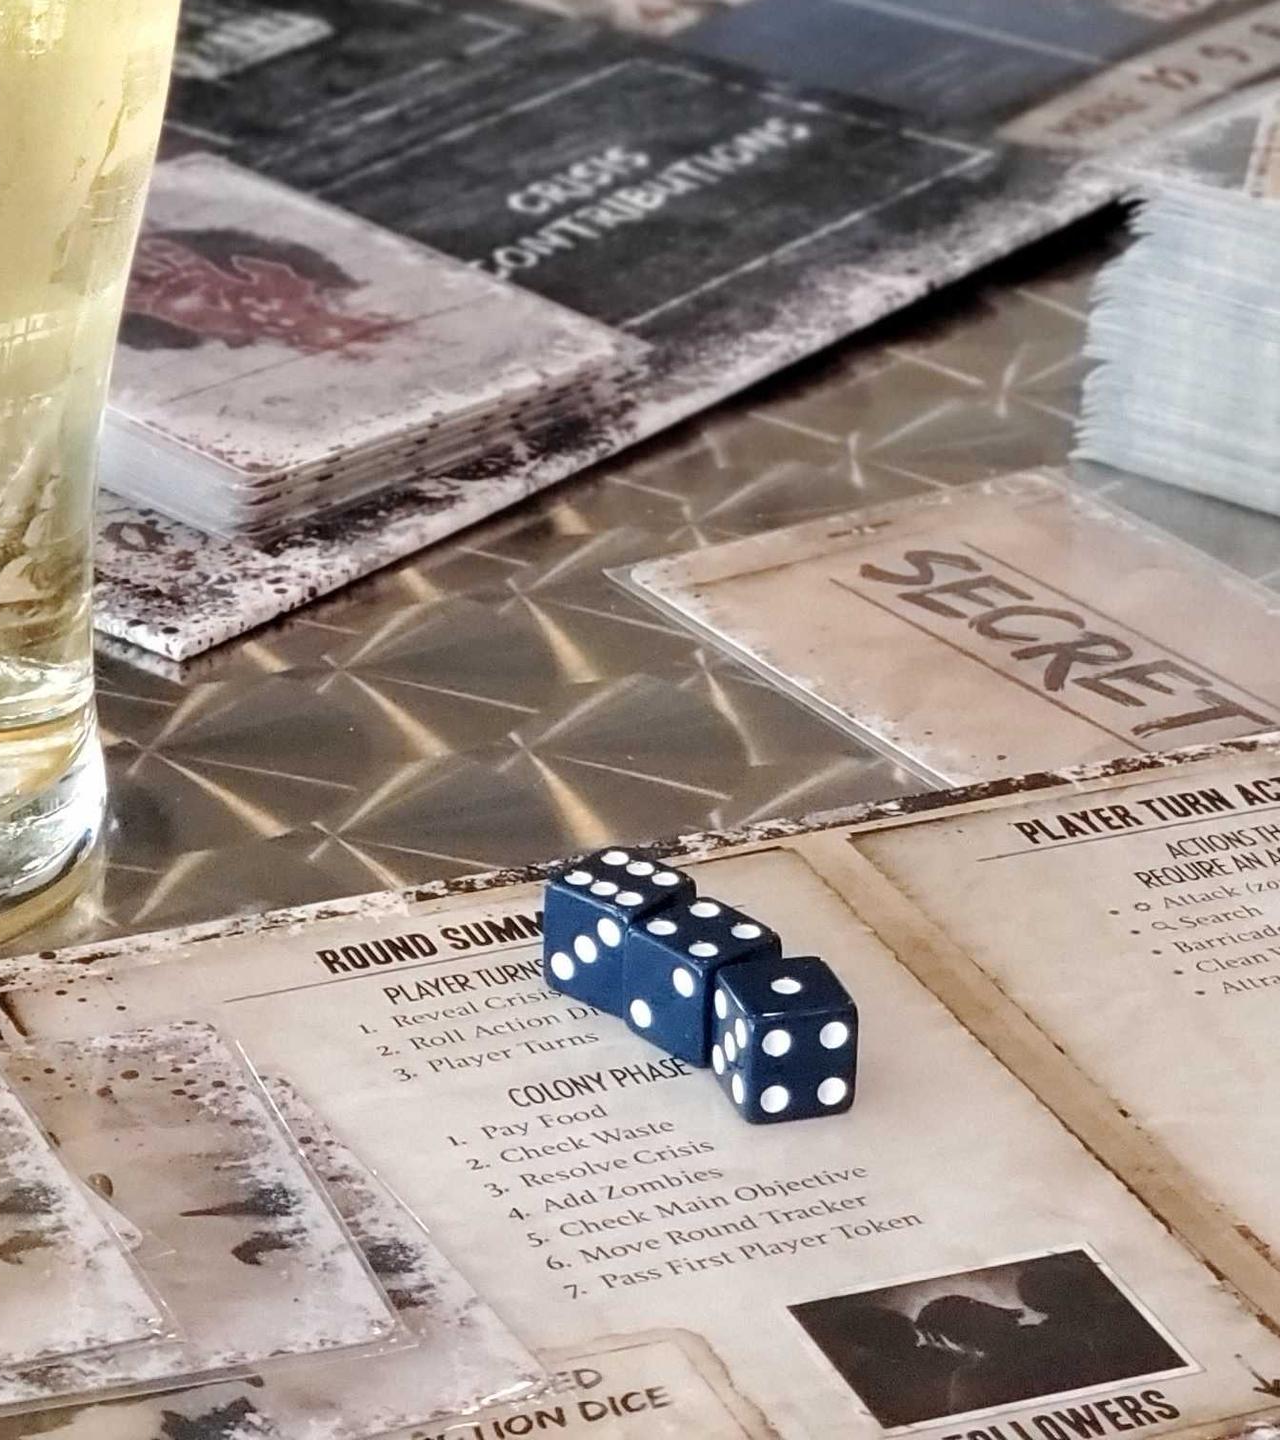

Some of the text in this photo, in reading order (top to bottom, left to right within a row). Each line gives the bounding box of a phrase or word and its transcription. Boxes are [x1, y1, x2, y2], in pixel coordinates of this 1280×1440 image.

[507, 146, 649, 215] CRISIS
[859, 550, 1277, 738] SECRET
[1014, 804, 1145, 845] PLAYER
[1139, 788, 1237, 824] TURN
[1134, 857, 1236, 890] REQUIRE
[1232, 848, 1270, 871] AN
[1166, 828, 1260, 860] ACTIONS
[1162, 885, 1239, 909] Attack
[1178, 904, 1263, 930] Search
[316, 911, 544, 974] ROUND SUMM
[1195, 949, 1270, 973] Clean
[358, 988, 563, 1034] 1. Reveal Crisis
[383, 970, 479, 1005] PLAYER
[377, 1006, 600, 1057] 2. Roll Action Di
[393, 1031, 600, 1082] 3. Player Turns
[508, 1057, 692, 1108] COLONY PHASE
[447, 1104, 608, 1147] 1. Pay Food
[466, 1119, 676, 1171] 2. Check Waste
[484, 1139, 715, 1198] 3. Resolve Crisis
[509, 1166, 725, 1222] 4. Add Zombies
[526, 1165, 870, 1248] 5. Check Main Objective
[546, 1193, 870, 1271] 6. Move Round Tracker
[563, 1211, 924, 1300] 7. Pass First Player Token
[577, 1386, 671, 1422] DICE
